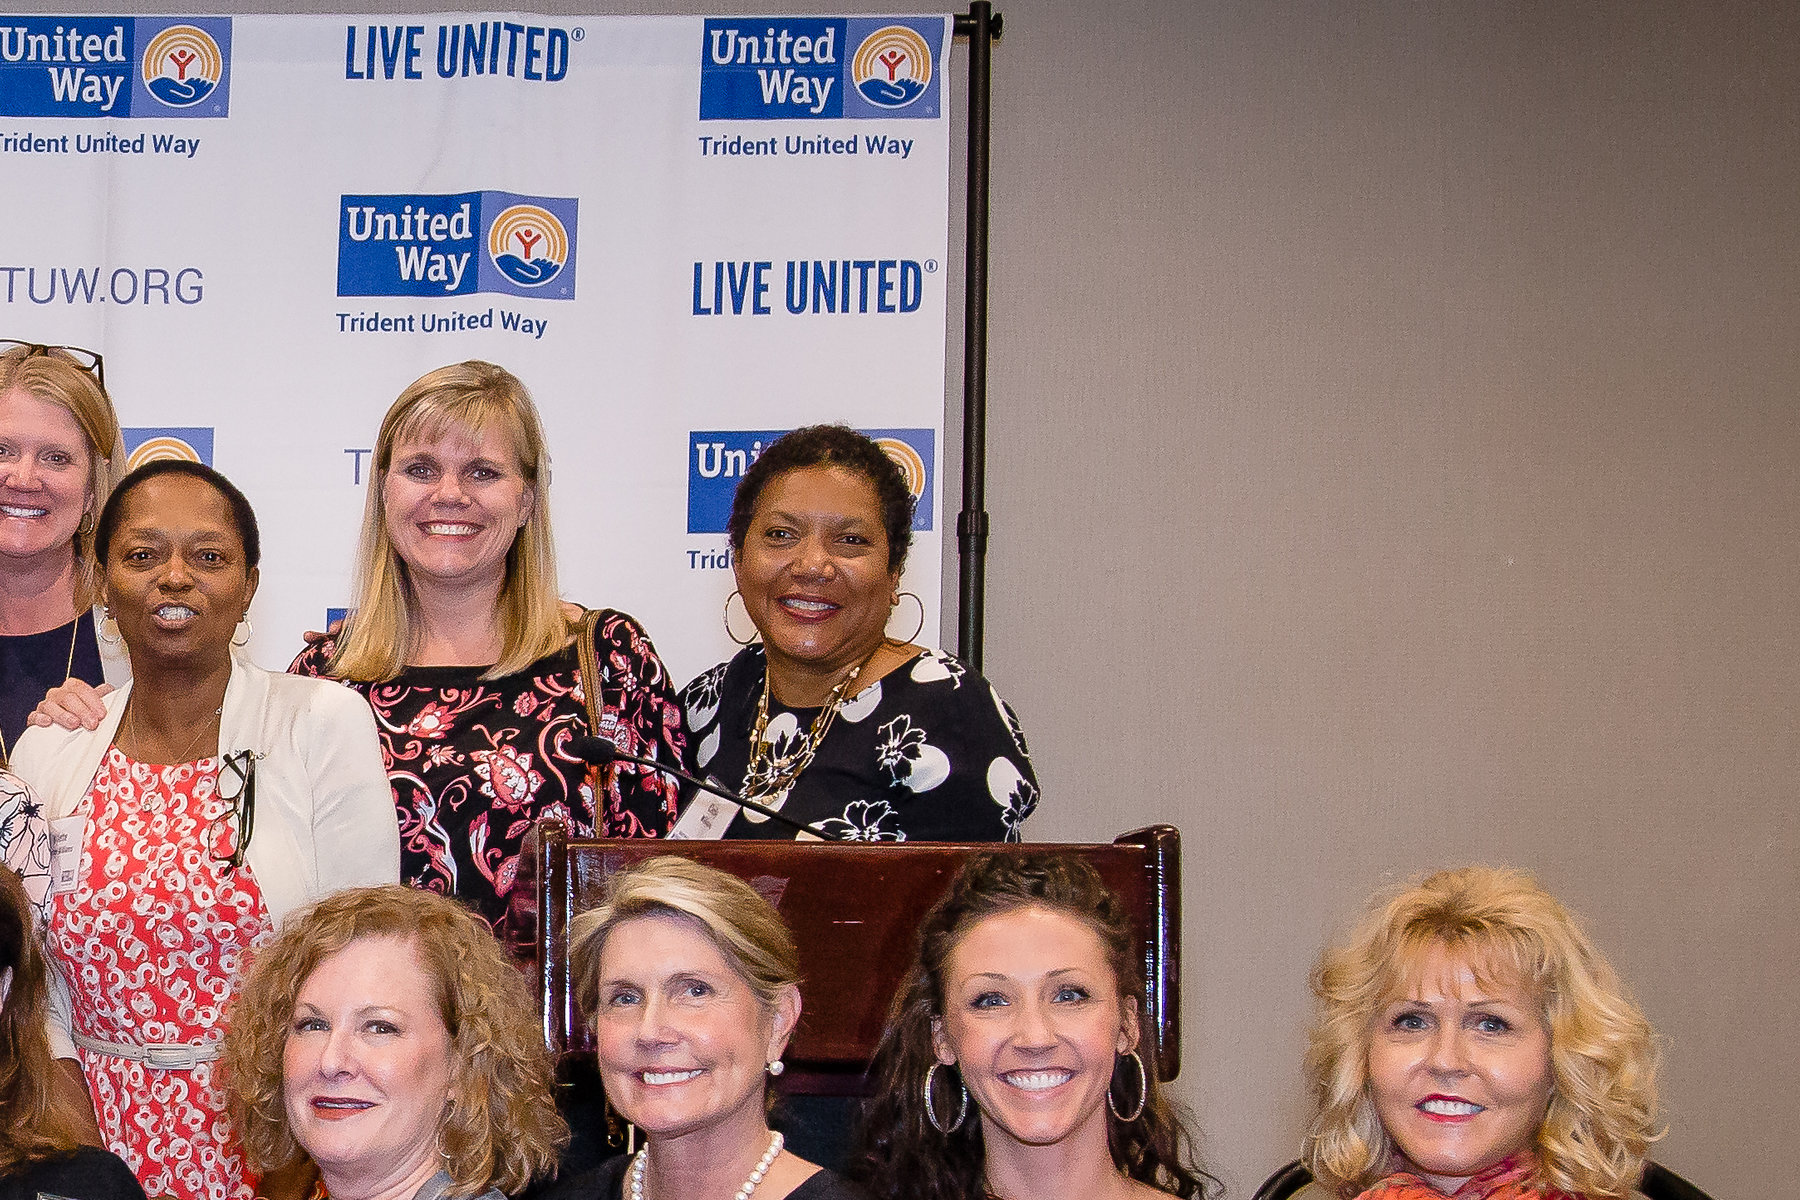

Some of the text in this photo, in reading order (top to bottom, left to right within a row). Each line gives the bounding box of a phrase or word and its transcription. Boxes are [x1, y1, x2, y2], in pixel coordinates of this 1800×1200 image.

[0, 26, 126, 62] United
[345, 25, 425, 80] LIVE
[711, 27, 836, 65] United
[48, 67, 125, 111] Way
[758, 69, 834, 115] Way
[76, 130, 145, 154] United
[152, 134, 201, 159] Way
[698, 134, 914, 159] Trident United Way
[347, 203, 472, 242] United
[395, 246, 471, 290] Way
[692, 261, 773, 315] LIVE
[336, 308, 548, 339] Trident United Way
[687, 548, 734, 569] Trid
